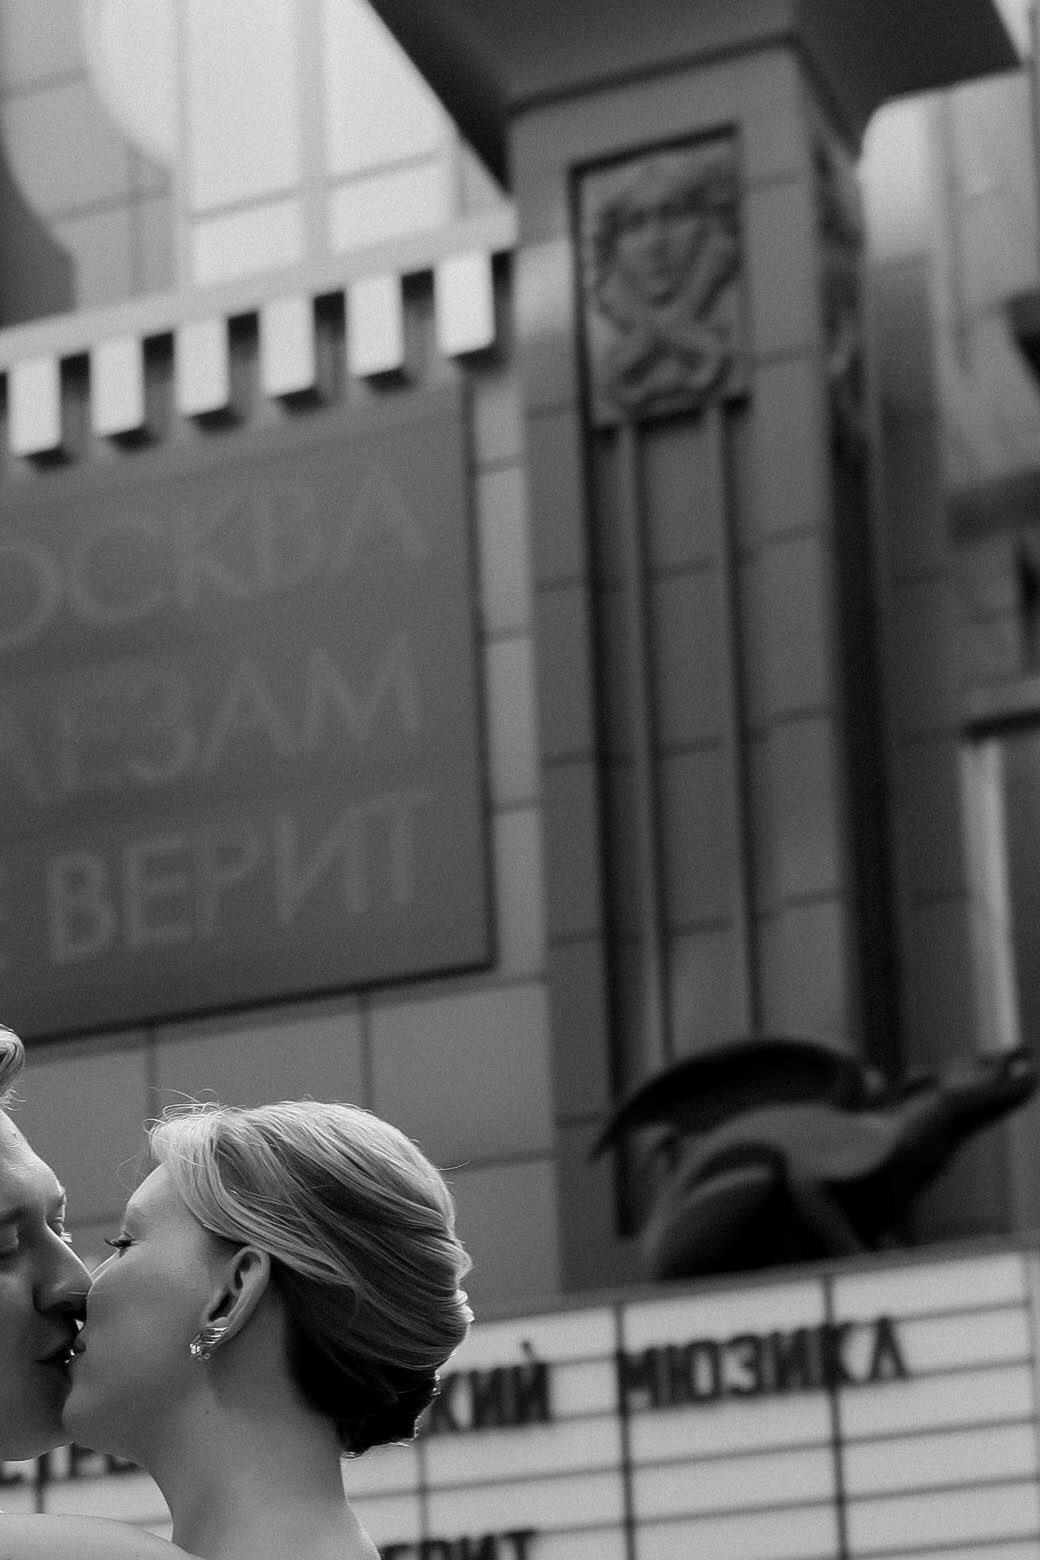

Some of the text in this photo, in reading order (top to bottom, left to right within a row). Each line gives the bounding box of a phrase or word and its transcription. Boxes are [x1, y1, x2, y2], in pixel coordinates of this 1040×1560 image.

[46, 788, 436, 966] ВЕРИТ
[432, 1316, 907, 1434] КИЙ МЮЗИКЛ
